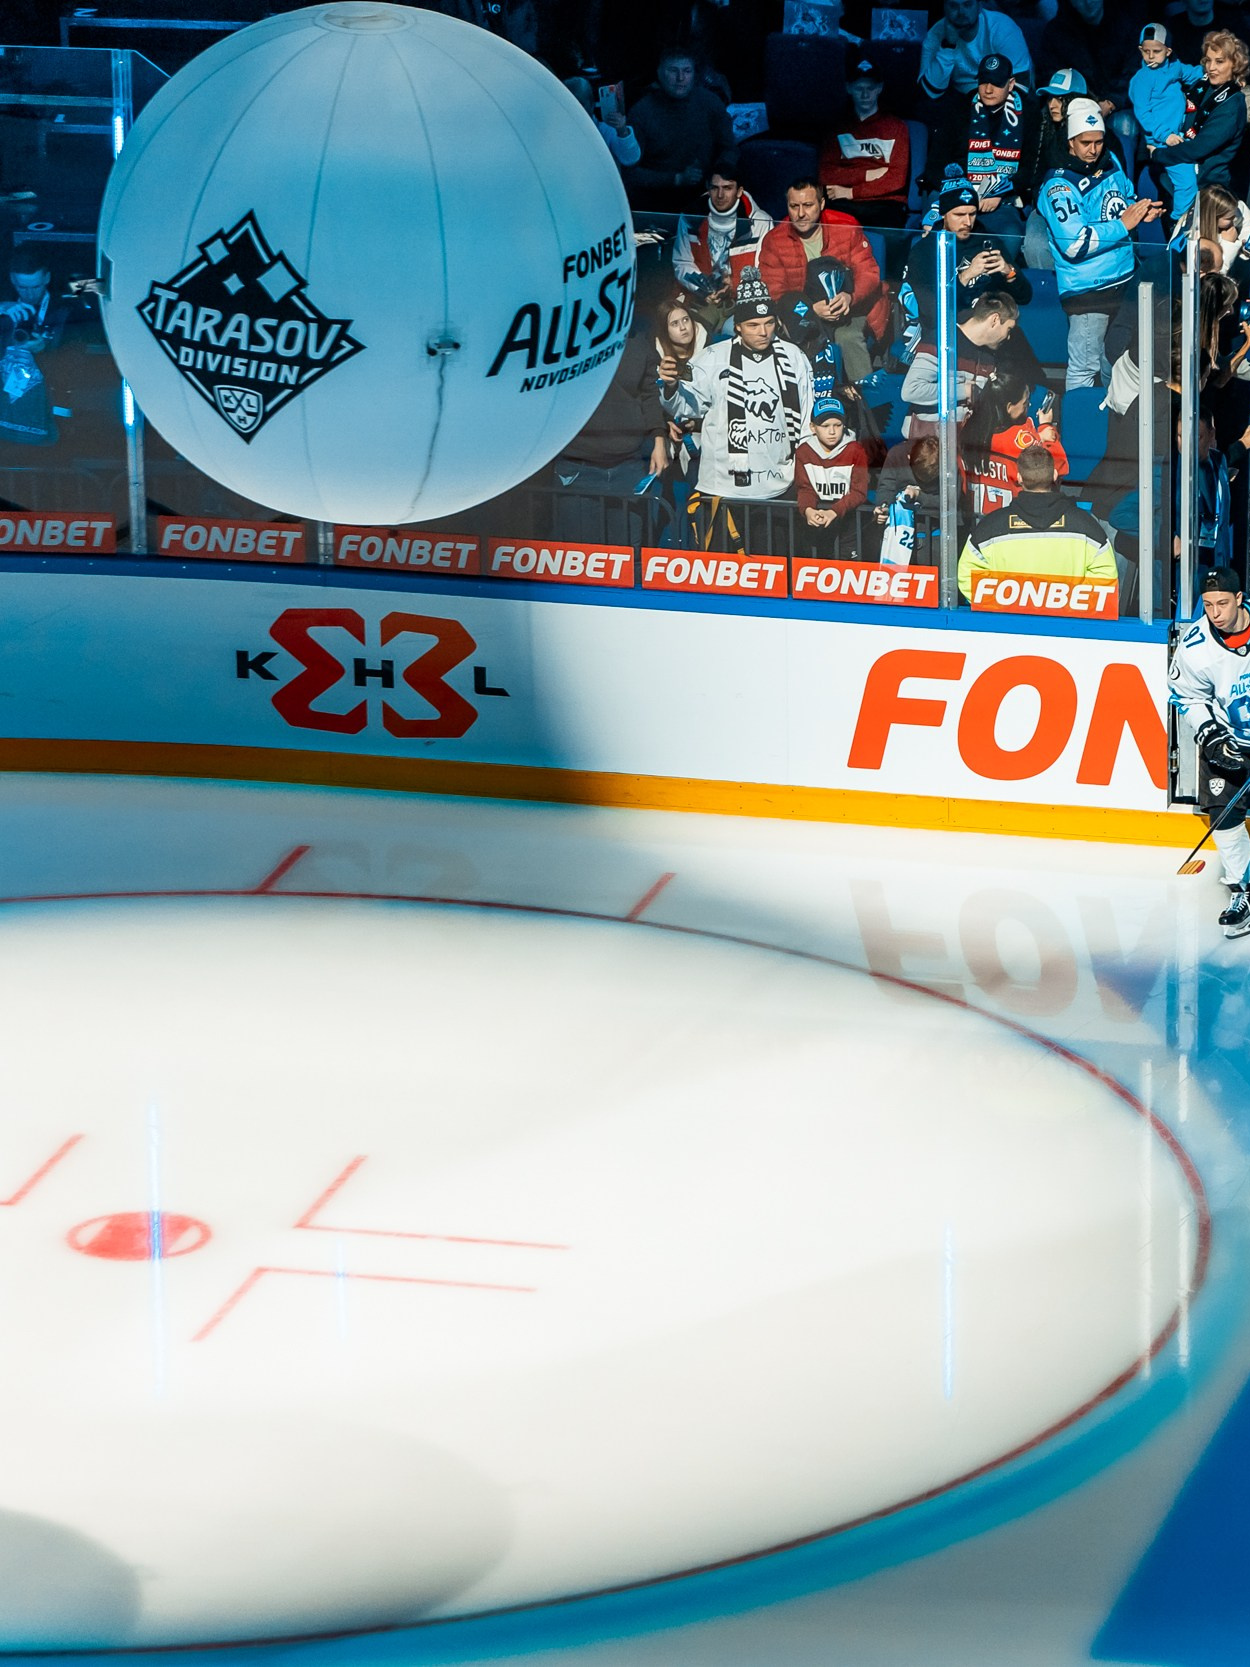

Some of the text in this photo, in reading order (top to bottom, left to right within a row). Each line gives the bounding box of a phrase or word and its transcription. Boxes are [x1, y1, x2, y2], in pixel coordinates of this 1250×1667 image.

[1051, 197, 1081, 223] 54
[563, 222, 627, 283] FONBET
[152, 286, 342, 360] TARASOV
[178, 346, 300, 385] DIVISION
[0, 519, 112, 547] ONBET
[161, 524, 303, 557] FONBET
[338, 535, 476, 569] FONBET
[491, 545, 631, 580] FONBET
[645, 556, 784, 590] FONBET
[795, 565, 935, 600] FONBET
[974, 578, 1116, 612] FONBET
[1183, 625, 1206, 649] 97
